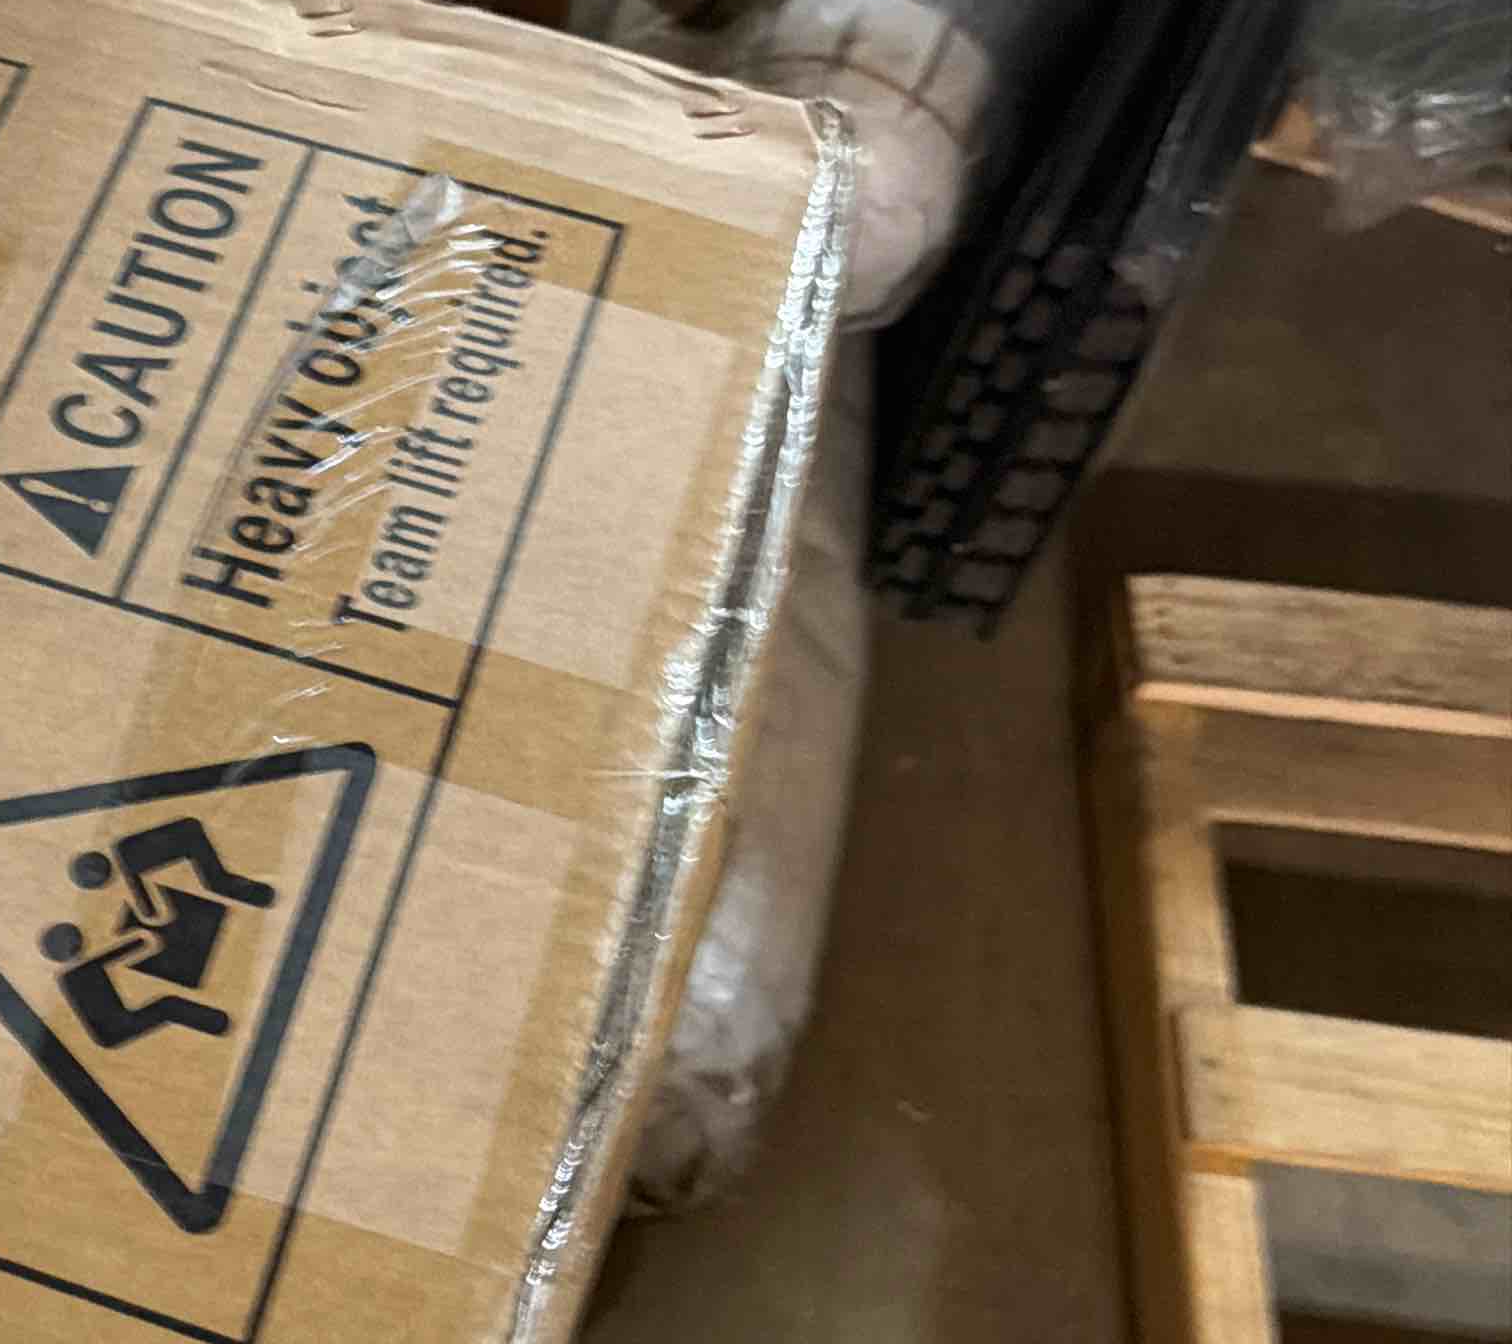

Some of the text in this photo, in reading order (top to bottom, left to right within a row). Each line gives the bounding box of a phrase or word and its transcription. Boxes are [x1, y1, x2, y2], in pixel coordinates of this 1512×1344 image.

[48, 136, 266, 451] CAUTION
[331, 226, 551, 634] Team lift required.
[179, 388, 360, 609] Heavy
